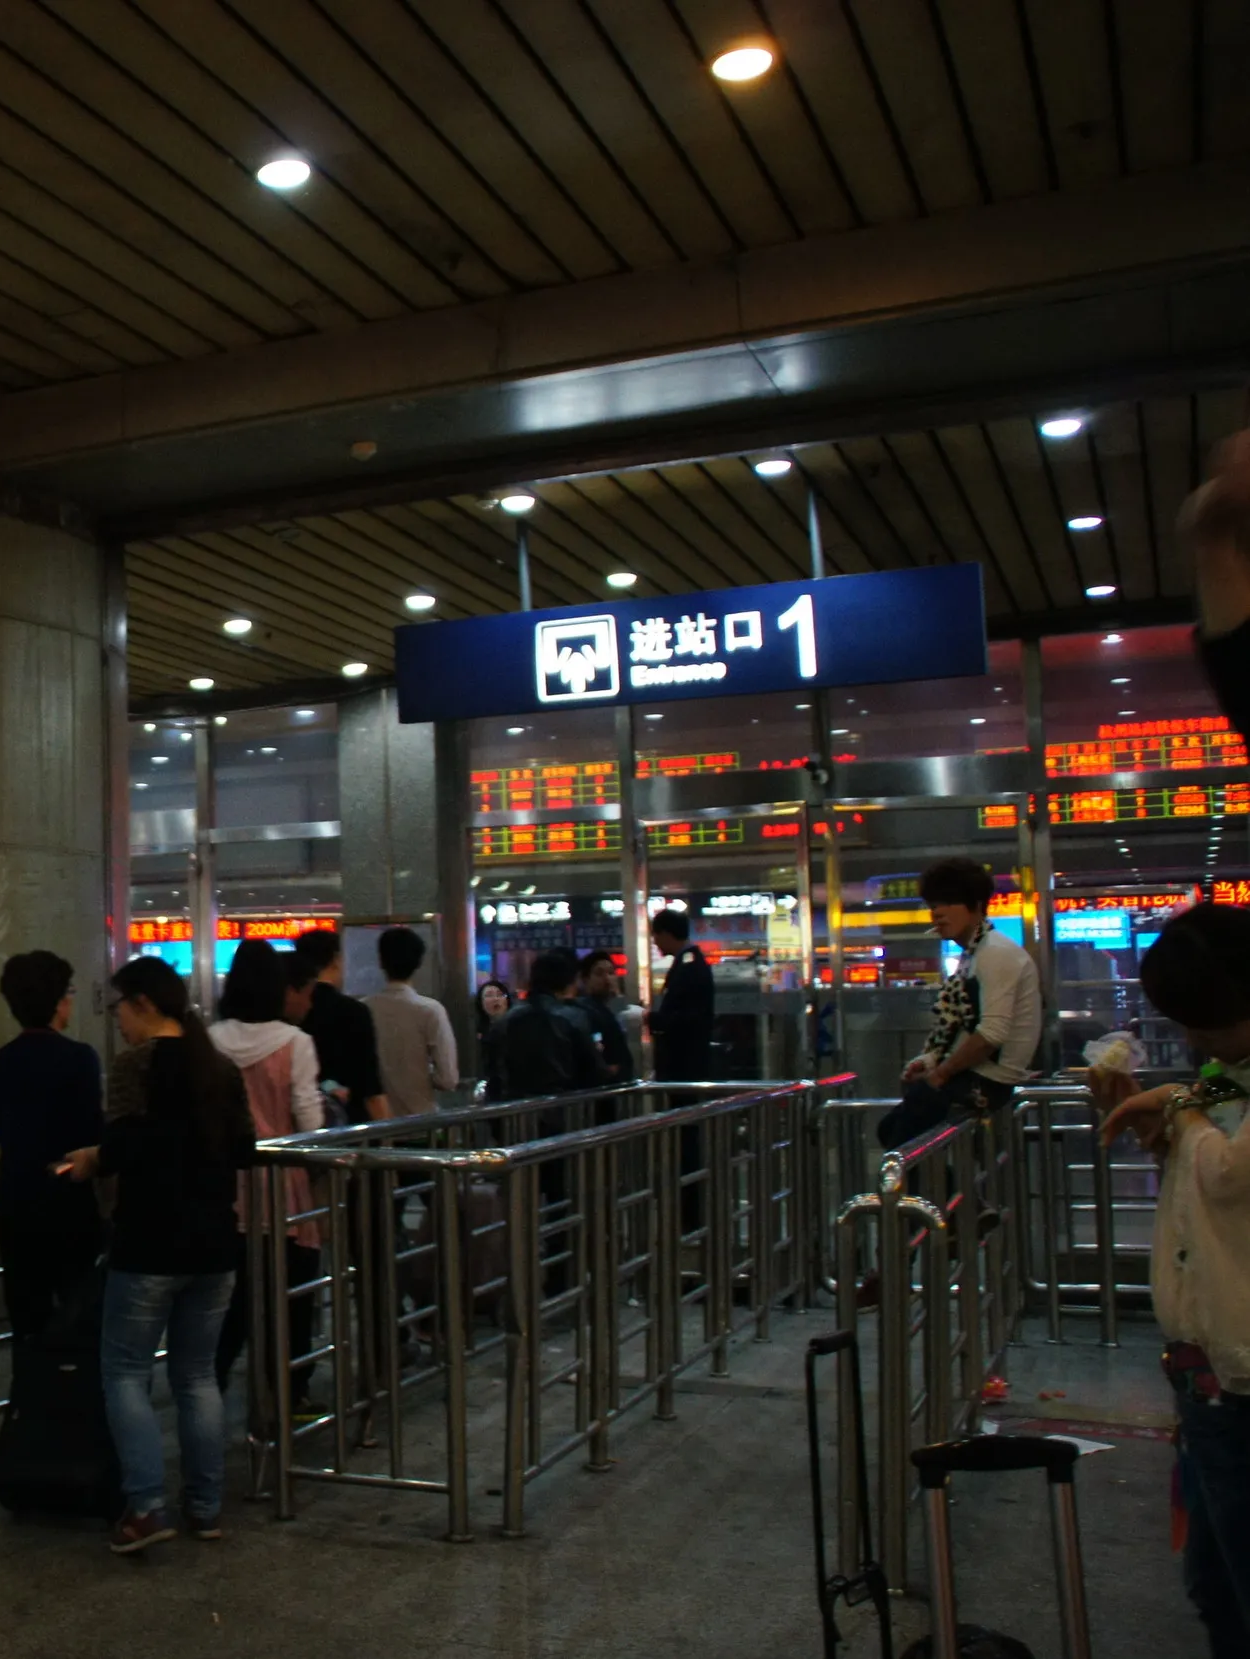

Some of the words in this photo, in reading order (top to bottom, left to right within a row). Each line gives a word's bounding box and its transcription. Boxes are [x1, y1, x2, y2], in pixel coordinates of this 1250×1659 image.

[629, 611, 763, 661] 进站口
[777, 593, 818, 678] 1
[629, 662, 727, 687] Entrance
